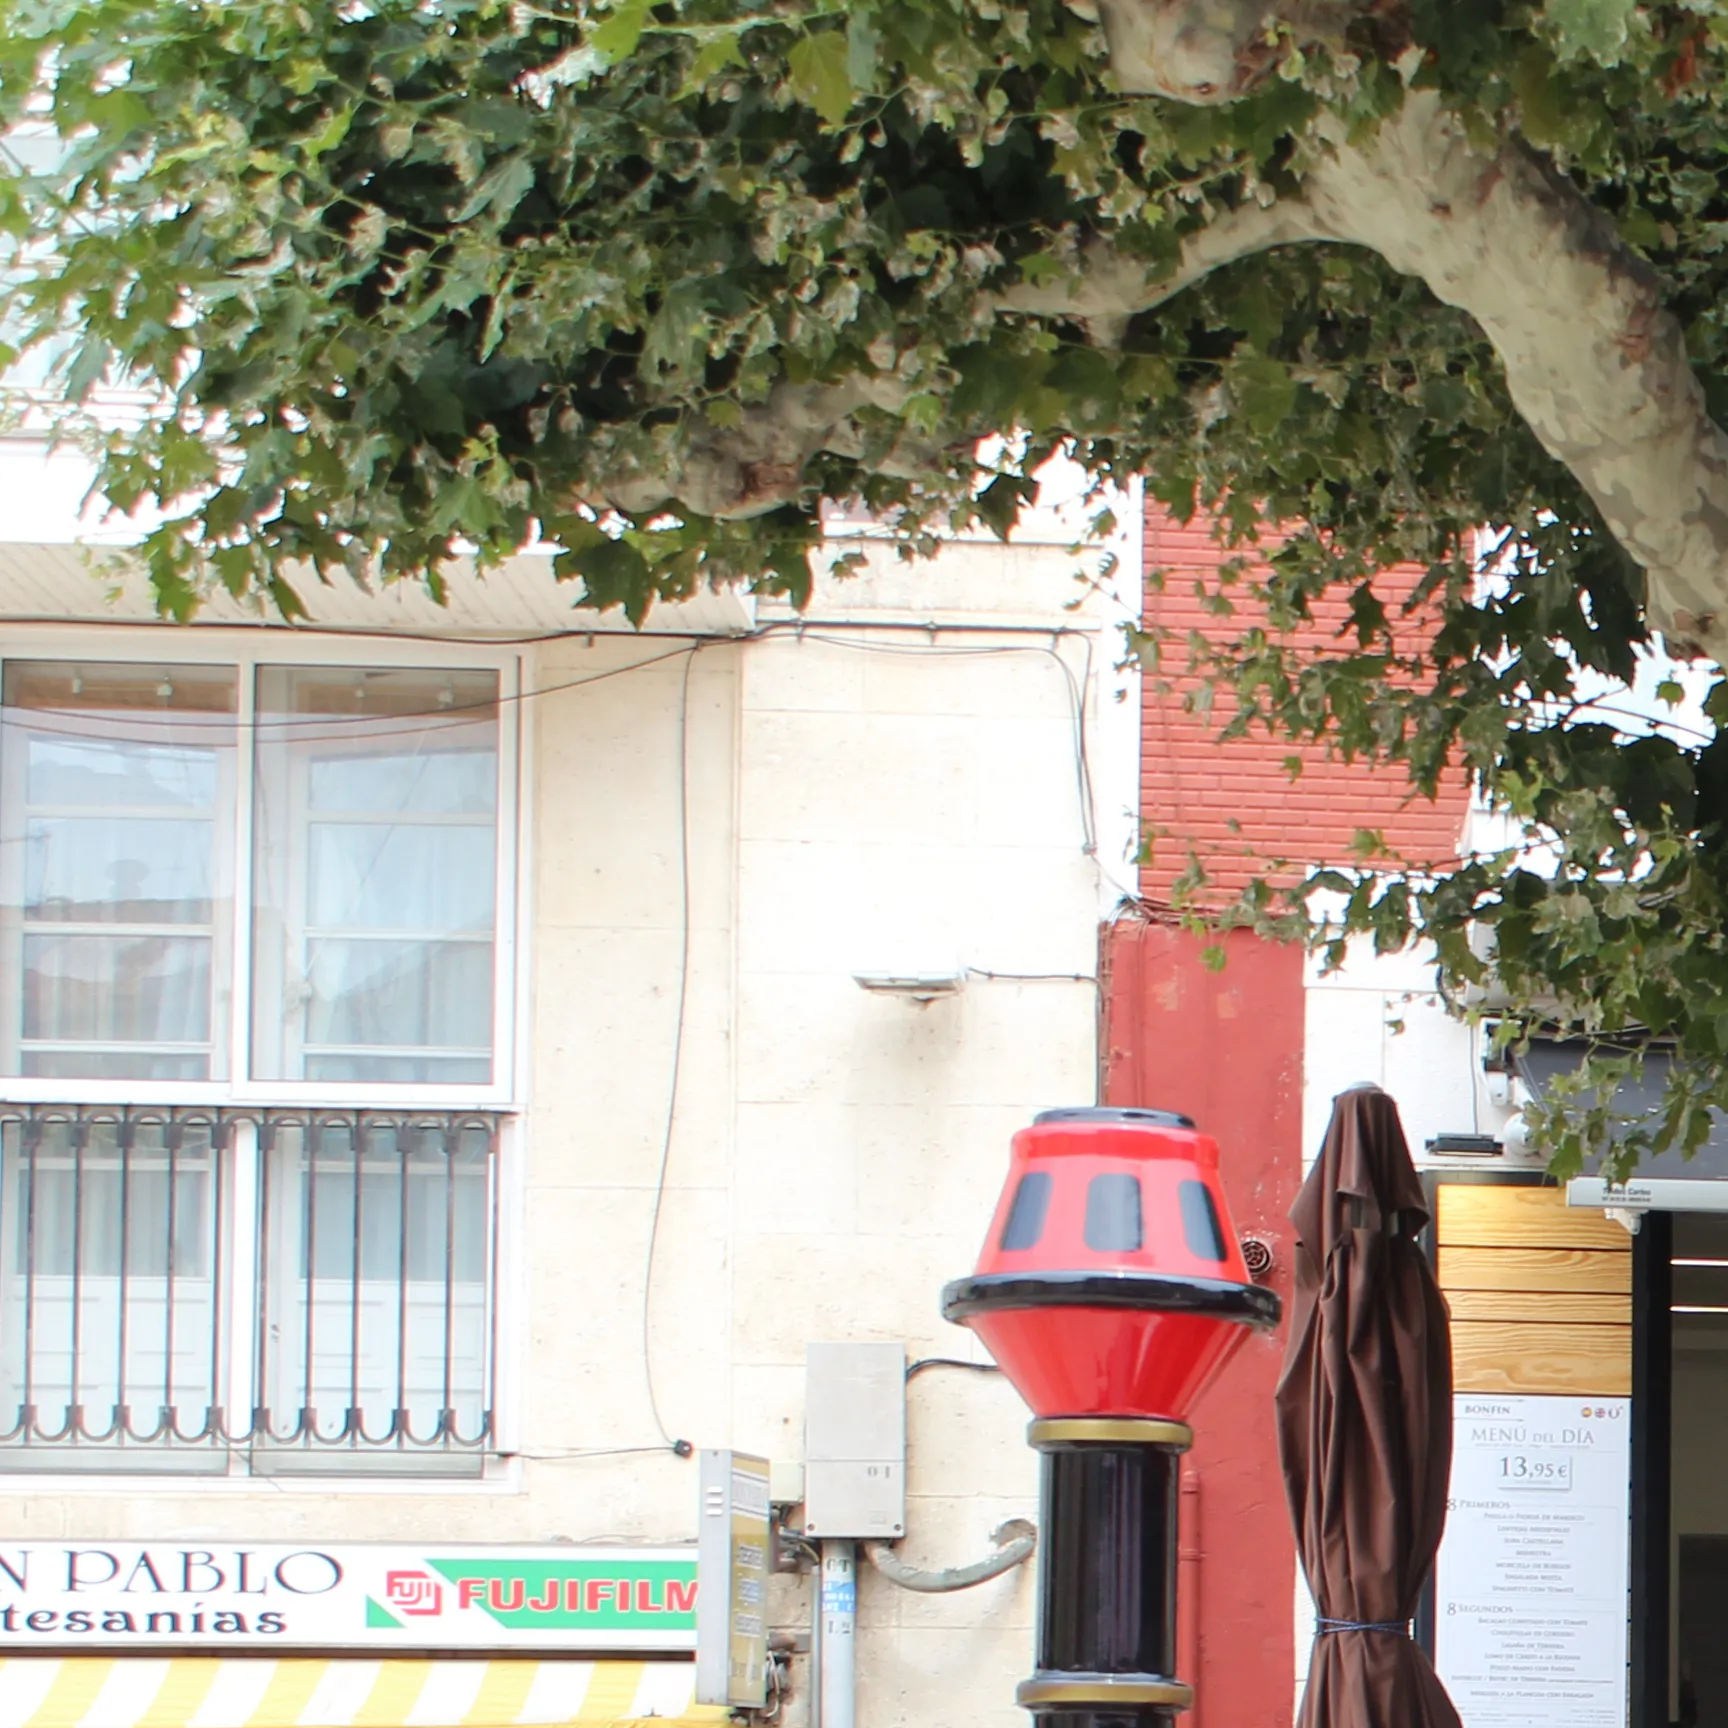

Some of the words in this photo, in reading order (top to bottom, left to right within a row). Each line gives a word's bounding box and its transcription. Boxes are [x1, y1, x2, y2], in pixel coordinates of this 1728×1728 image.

[1471, 1425, 1527, 1442] MENÚ
[1561, 1426, 1595, 1444] DÍA
[1501, 1456, 1554, 1479] 13,95
[63, 1550, 344, 1594] PABLO
[0, 1602, 288, 1634] tesanías
[1447, 1602, 1457, 1616] 8
